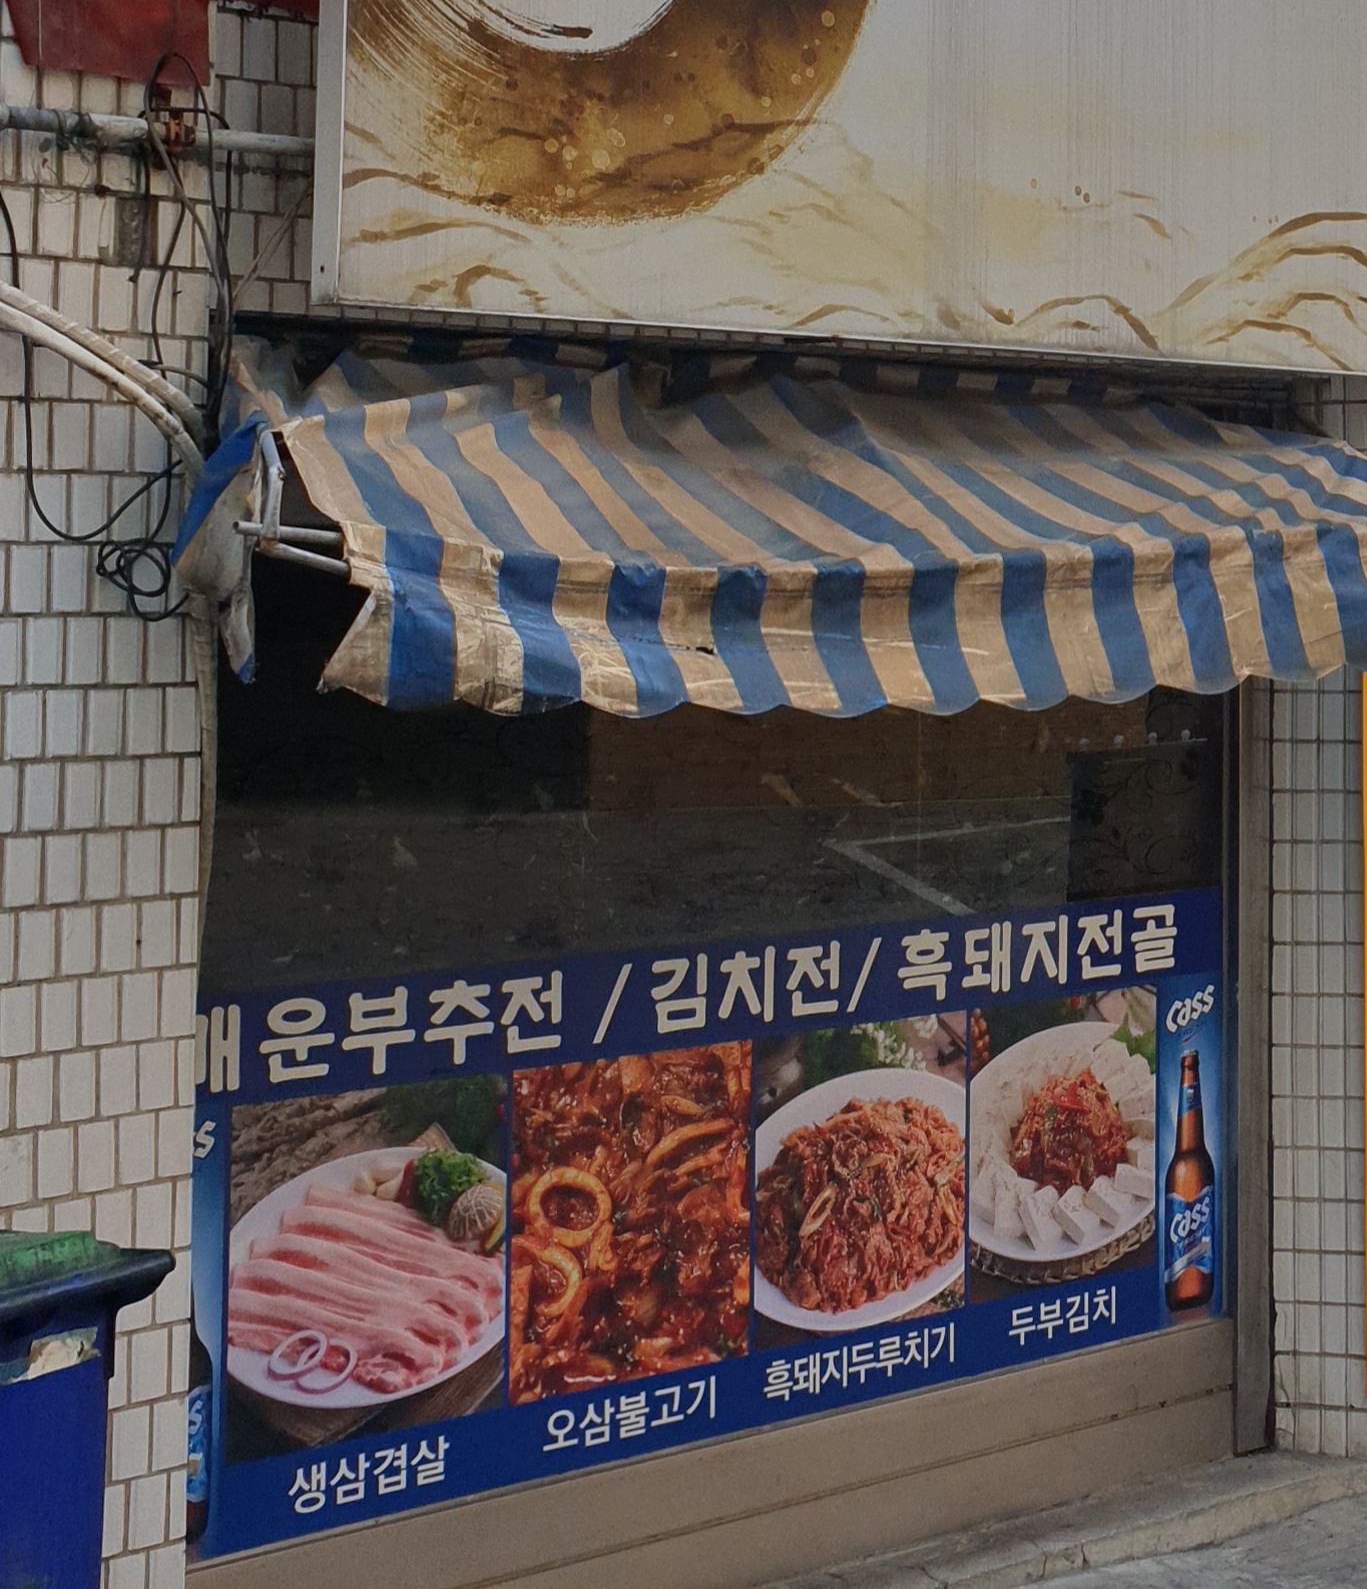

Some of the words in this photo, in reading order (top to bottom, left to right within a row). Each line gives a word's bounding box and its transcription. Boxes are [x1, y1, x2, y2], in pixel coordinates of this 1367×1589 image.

[897, 904, 1178, 1001] 흑돼지전골
[1008, 1286, 1119, 1347] 두부김치
[762, 1322, 956, 1402] 흑돼지두루치기
[541, 1375, 717, 1454] 오삼불고기
[286, 1434, 451, 1516] 생삼겹살
